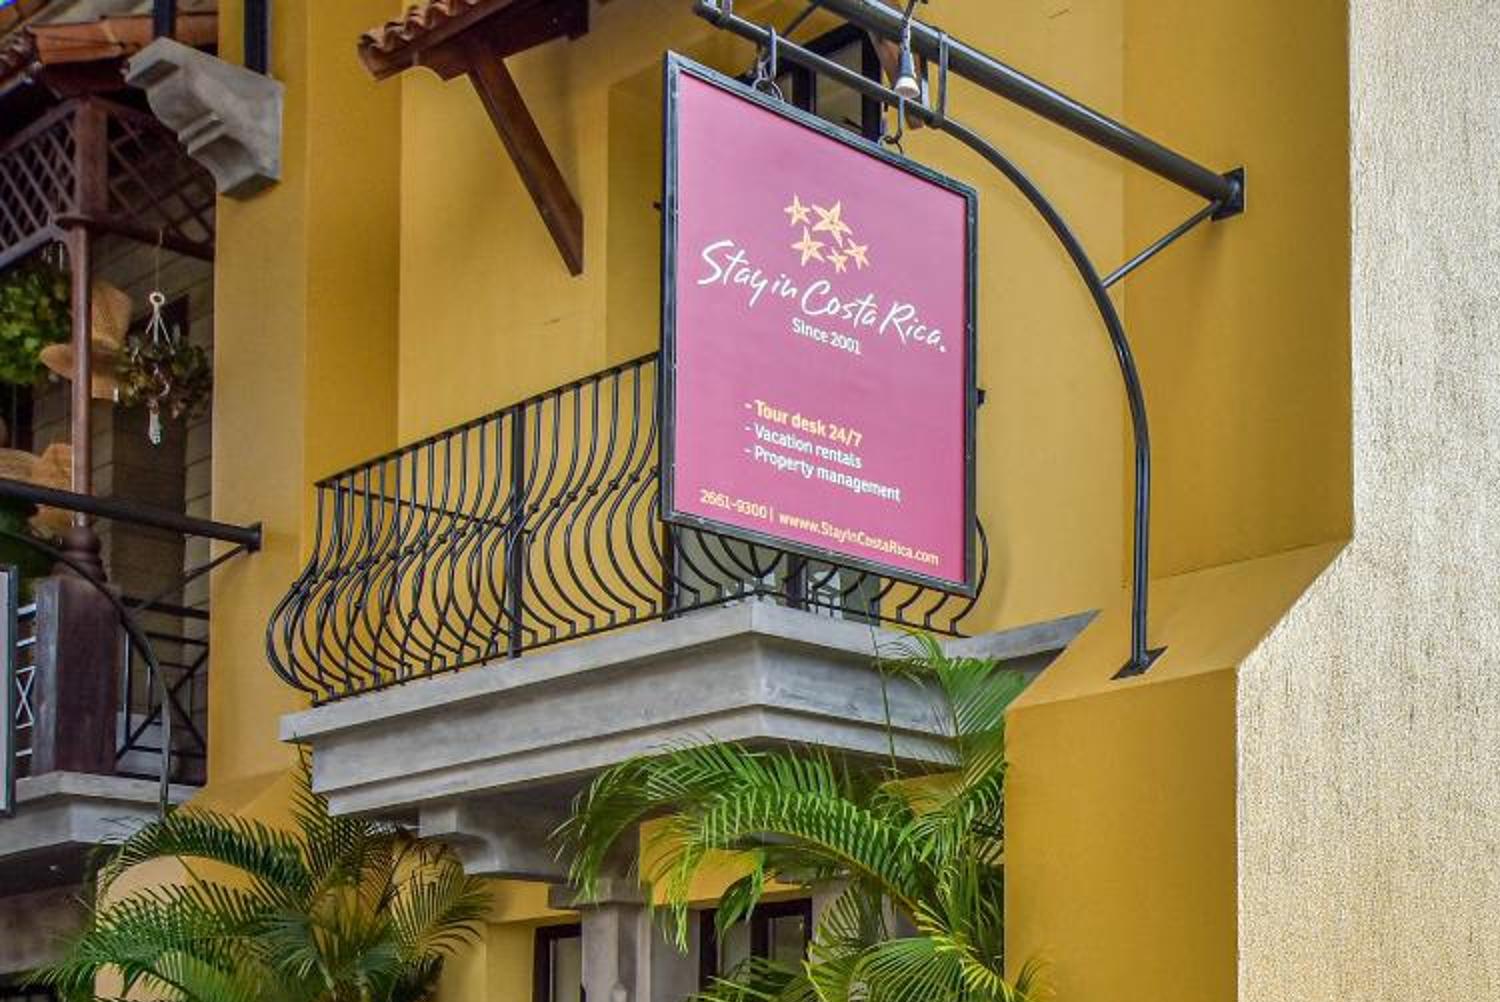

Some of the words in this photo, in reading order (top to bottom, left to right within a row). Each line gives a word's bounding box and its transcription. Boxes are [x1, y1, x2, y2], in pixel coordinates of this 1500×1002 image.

[697, 239, 768, 306] Stay
[772, 273, 798, 299] in
[801, 280, 876, 328] Costa
[791, 317, 829, 344] Since
[830, 333, 861, 354] 2001
[754, 399, 787, 425] Tour
[791, 412, 826, 437] desk
[829, 424, 862, 447] 24/7
[754, 423, 813, 455] Vacation
[815, 444, 862, 469] rentals
[754, 445, 814, 479] Property
[817, 466, 901, 502] management
[700, 489, 767, 520] 2661-9300
